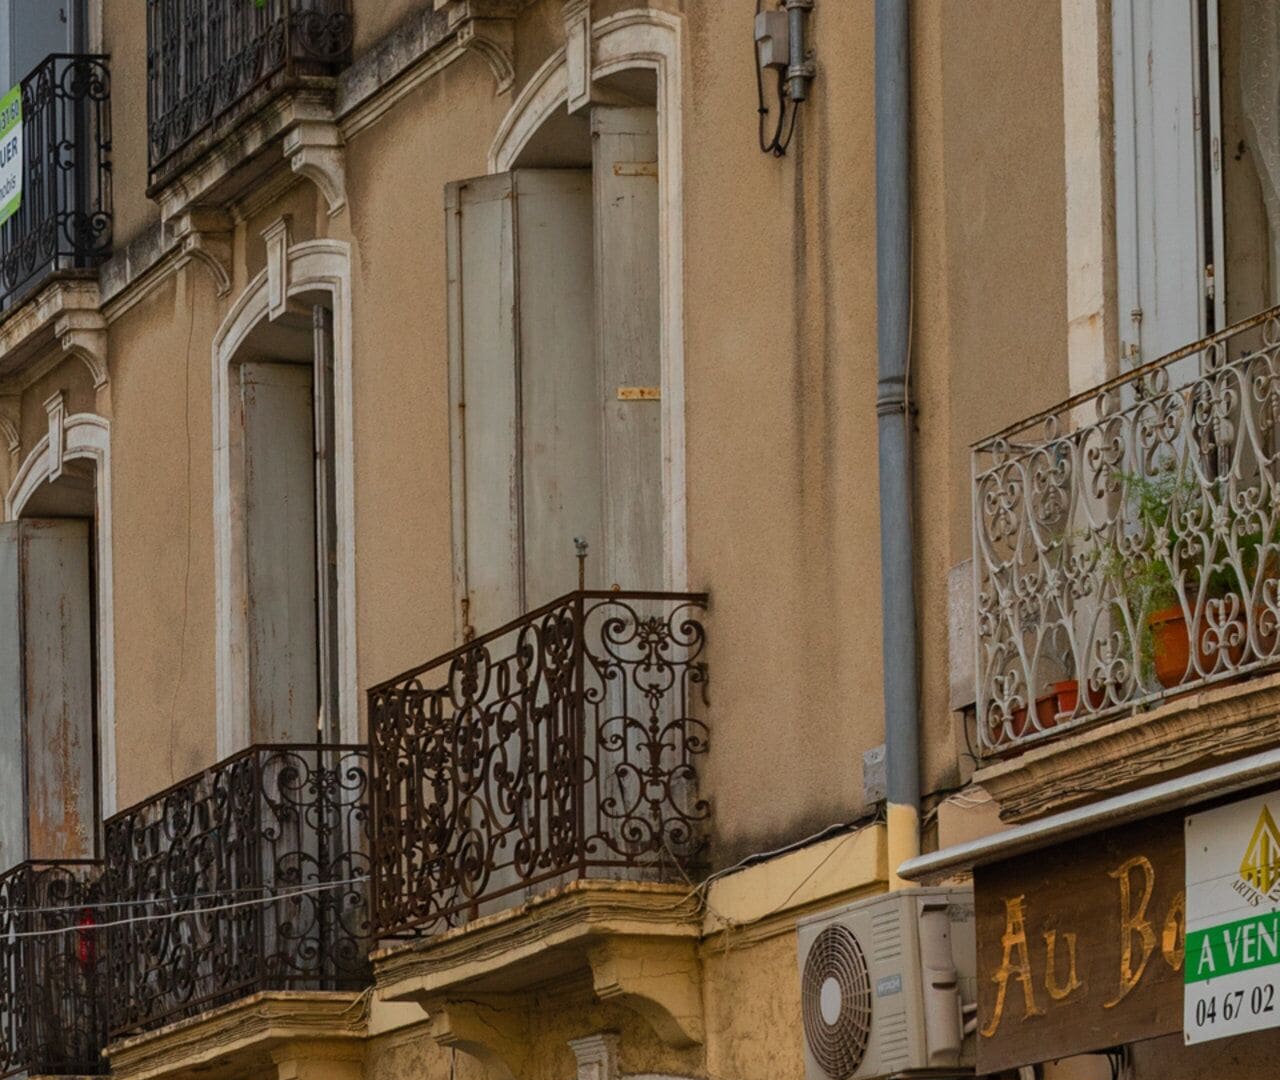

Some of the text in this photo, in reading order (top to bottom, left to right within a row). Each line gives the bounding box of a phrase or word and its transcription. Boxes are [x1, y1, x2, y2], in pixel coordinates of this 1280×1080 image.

[1230, 879, 1263, 908] ARTIS
[980, 893, 1084, 1038] Au
[1197, 917, 1278, 976] A VEN
[1196, 983, 1274, 1028] 04 67 02
